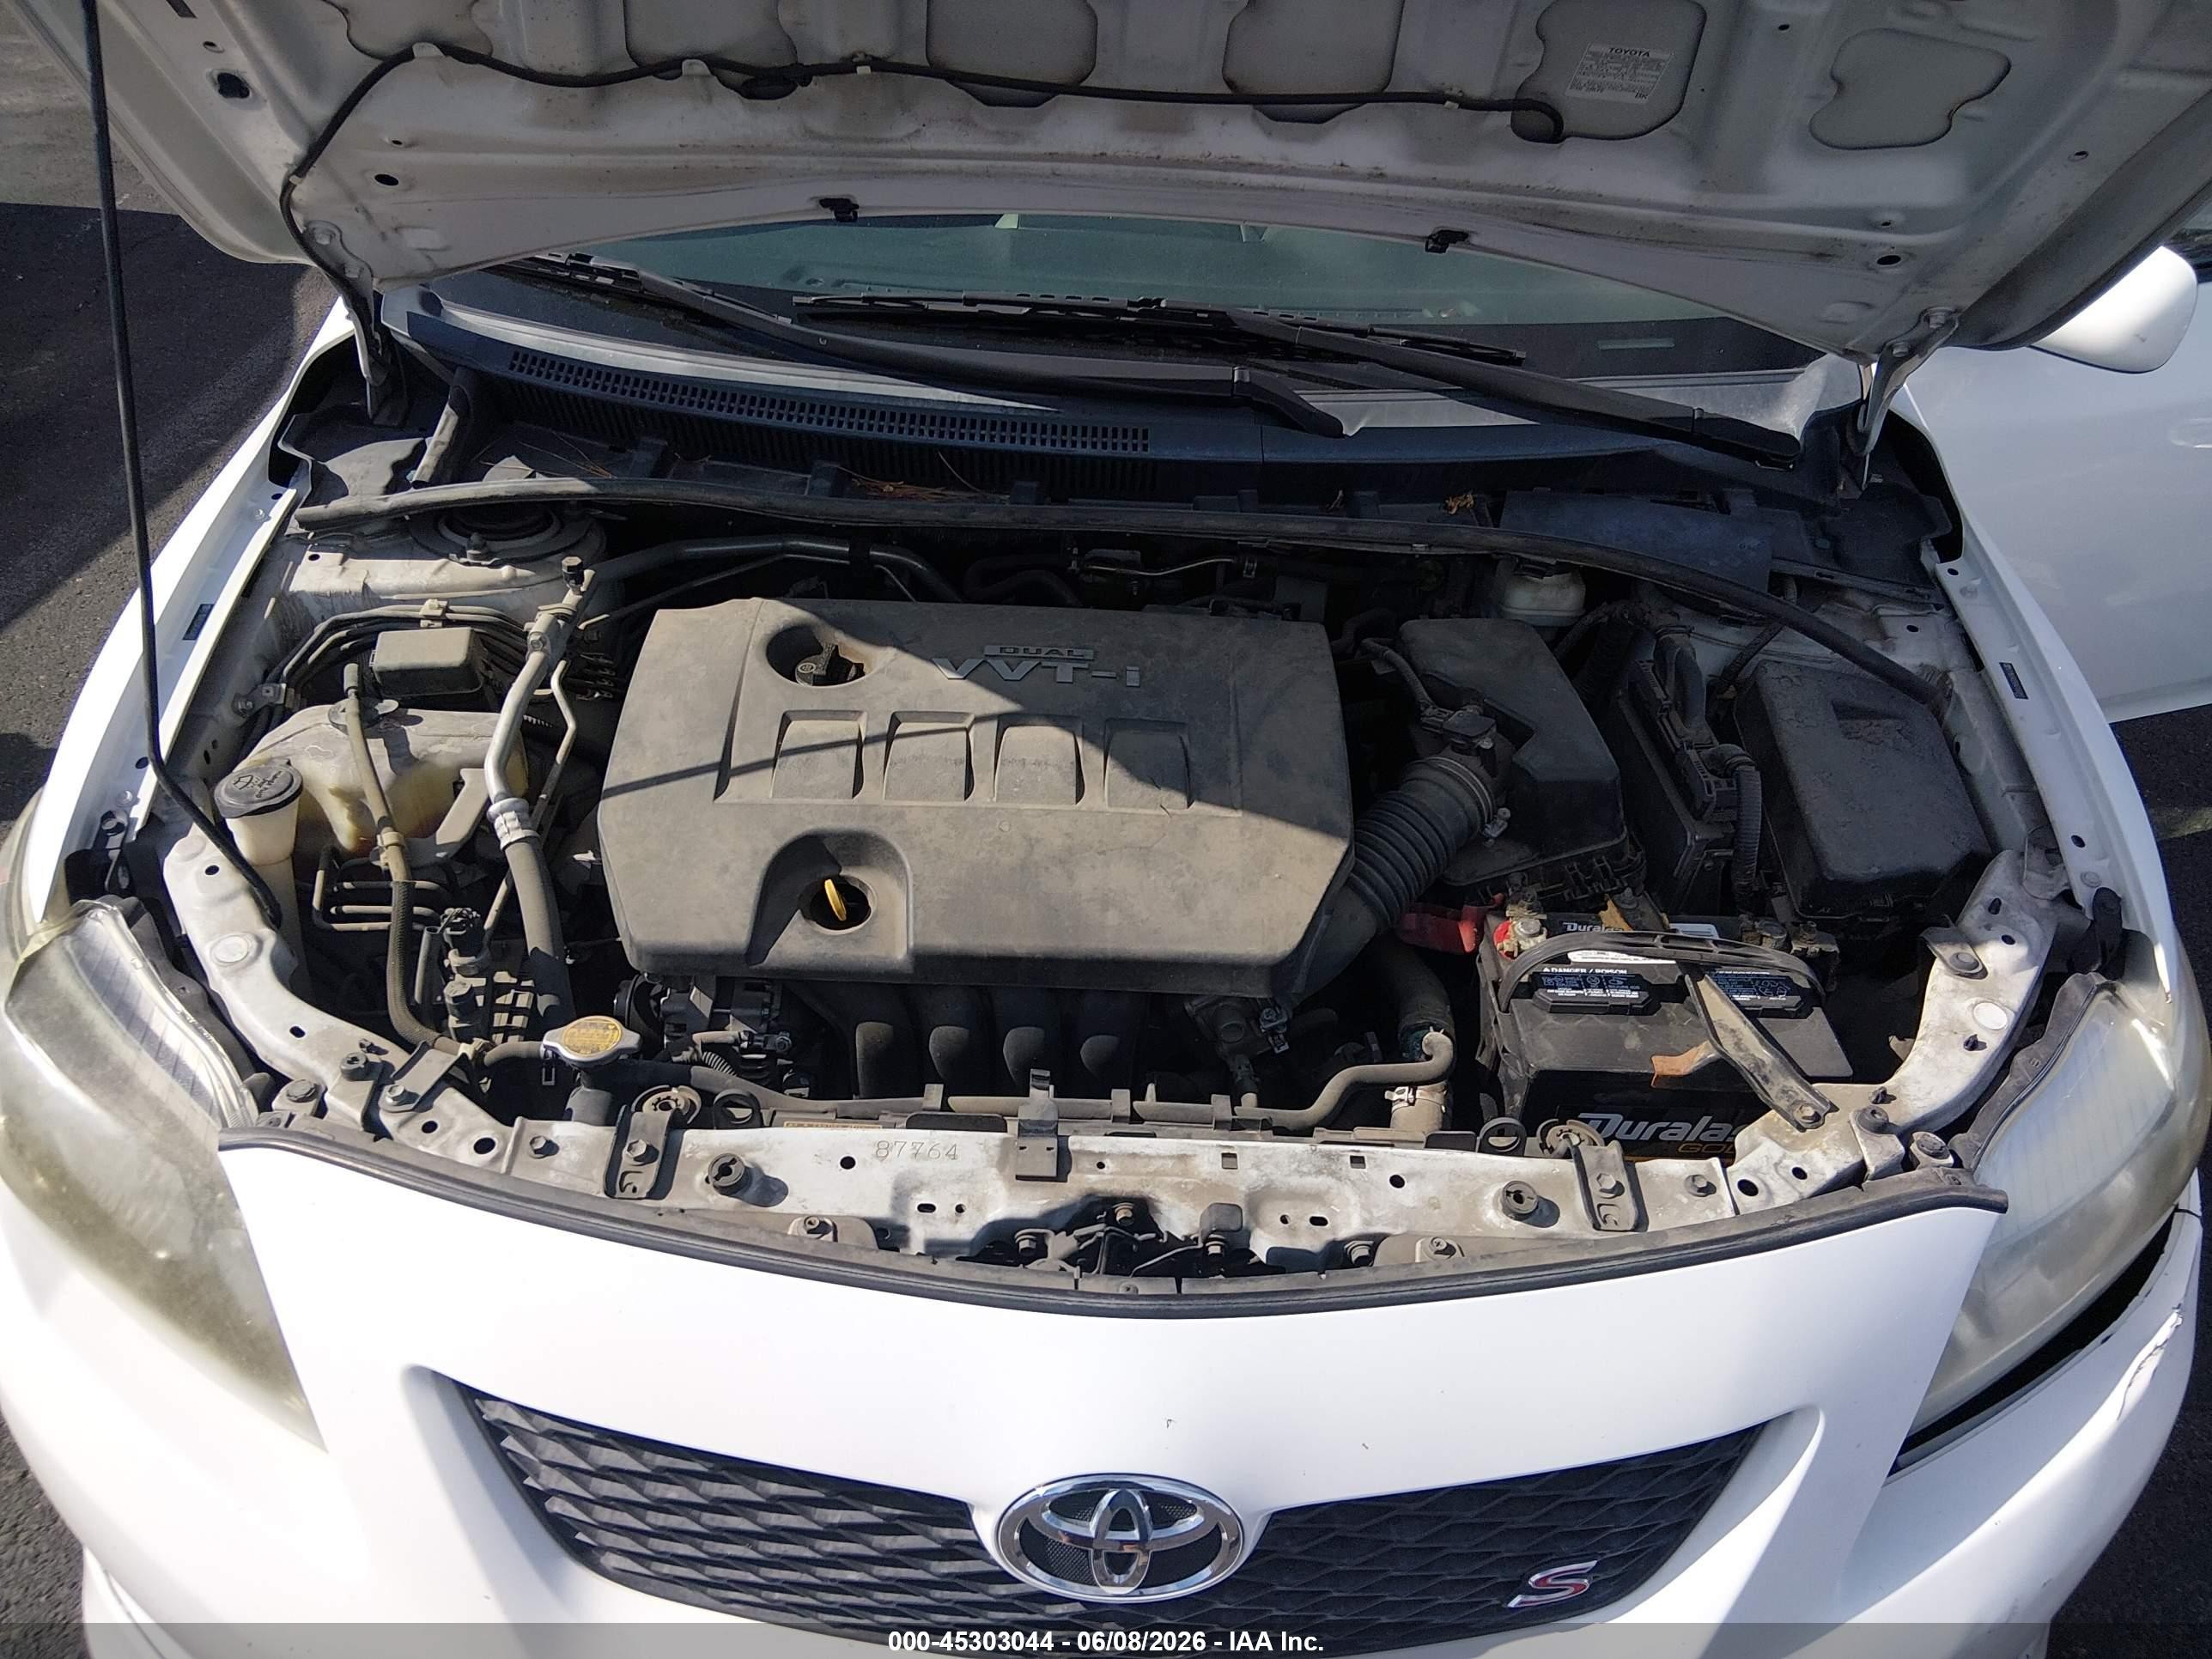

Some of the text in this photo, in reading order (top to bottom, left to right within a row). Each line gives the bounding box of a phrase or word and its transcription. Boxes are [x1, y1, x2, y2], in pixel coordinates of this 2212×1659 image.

[1608, 47, 1650, 58] TOYOTA
[999, 646, 1085, 658] DUAL
[932, 658, 1141, 688] VVT-i
[874, 1139, 959, 1161] 87764
[1506, 1559, 1599, 1608] S
